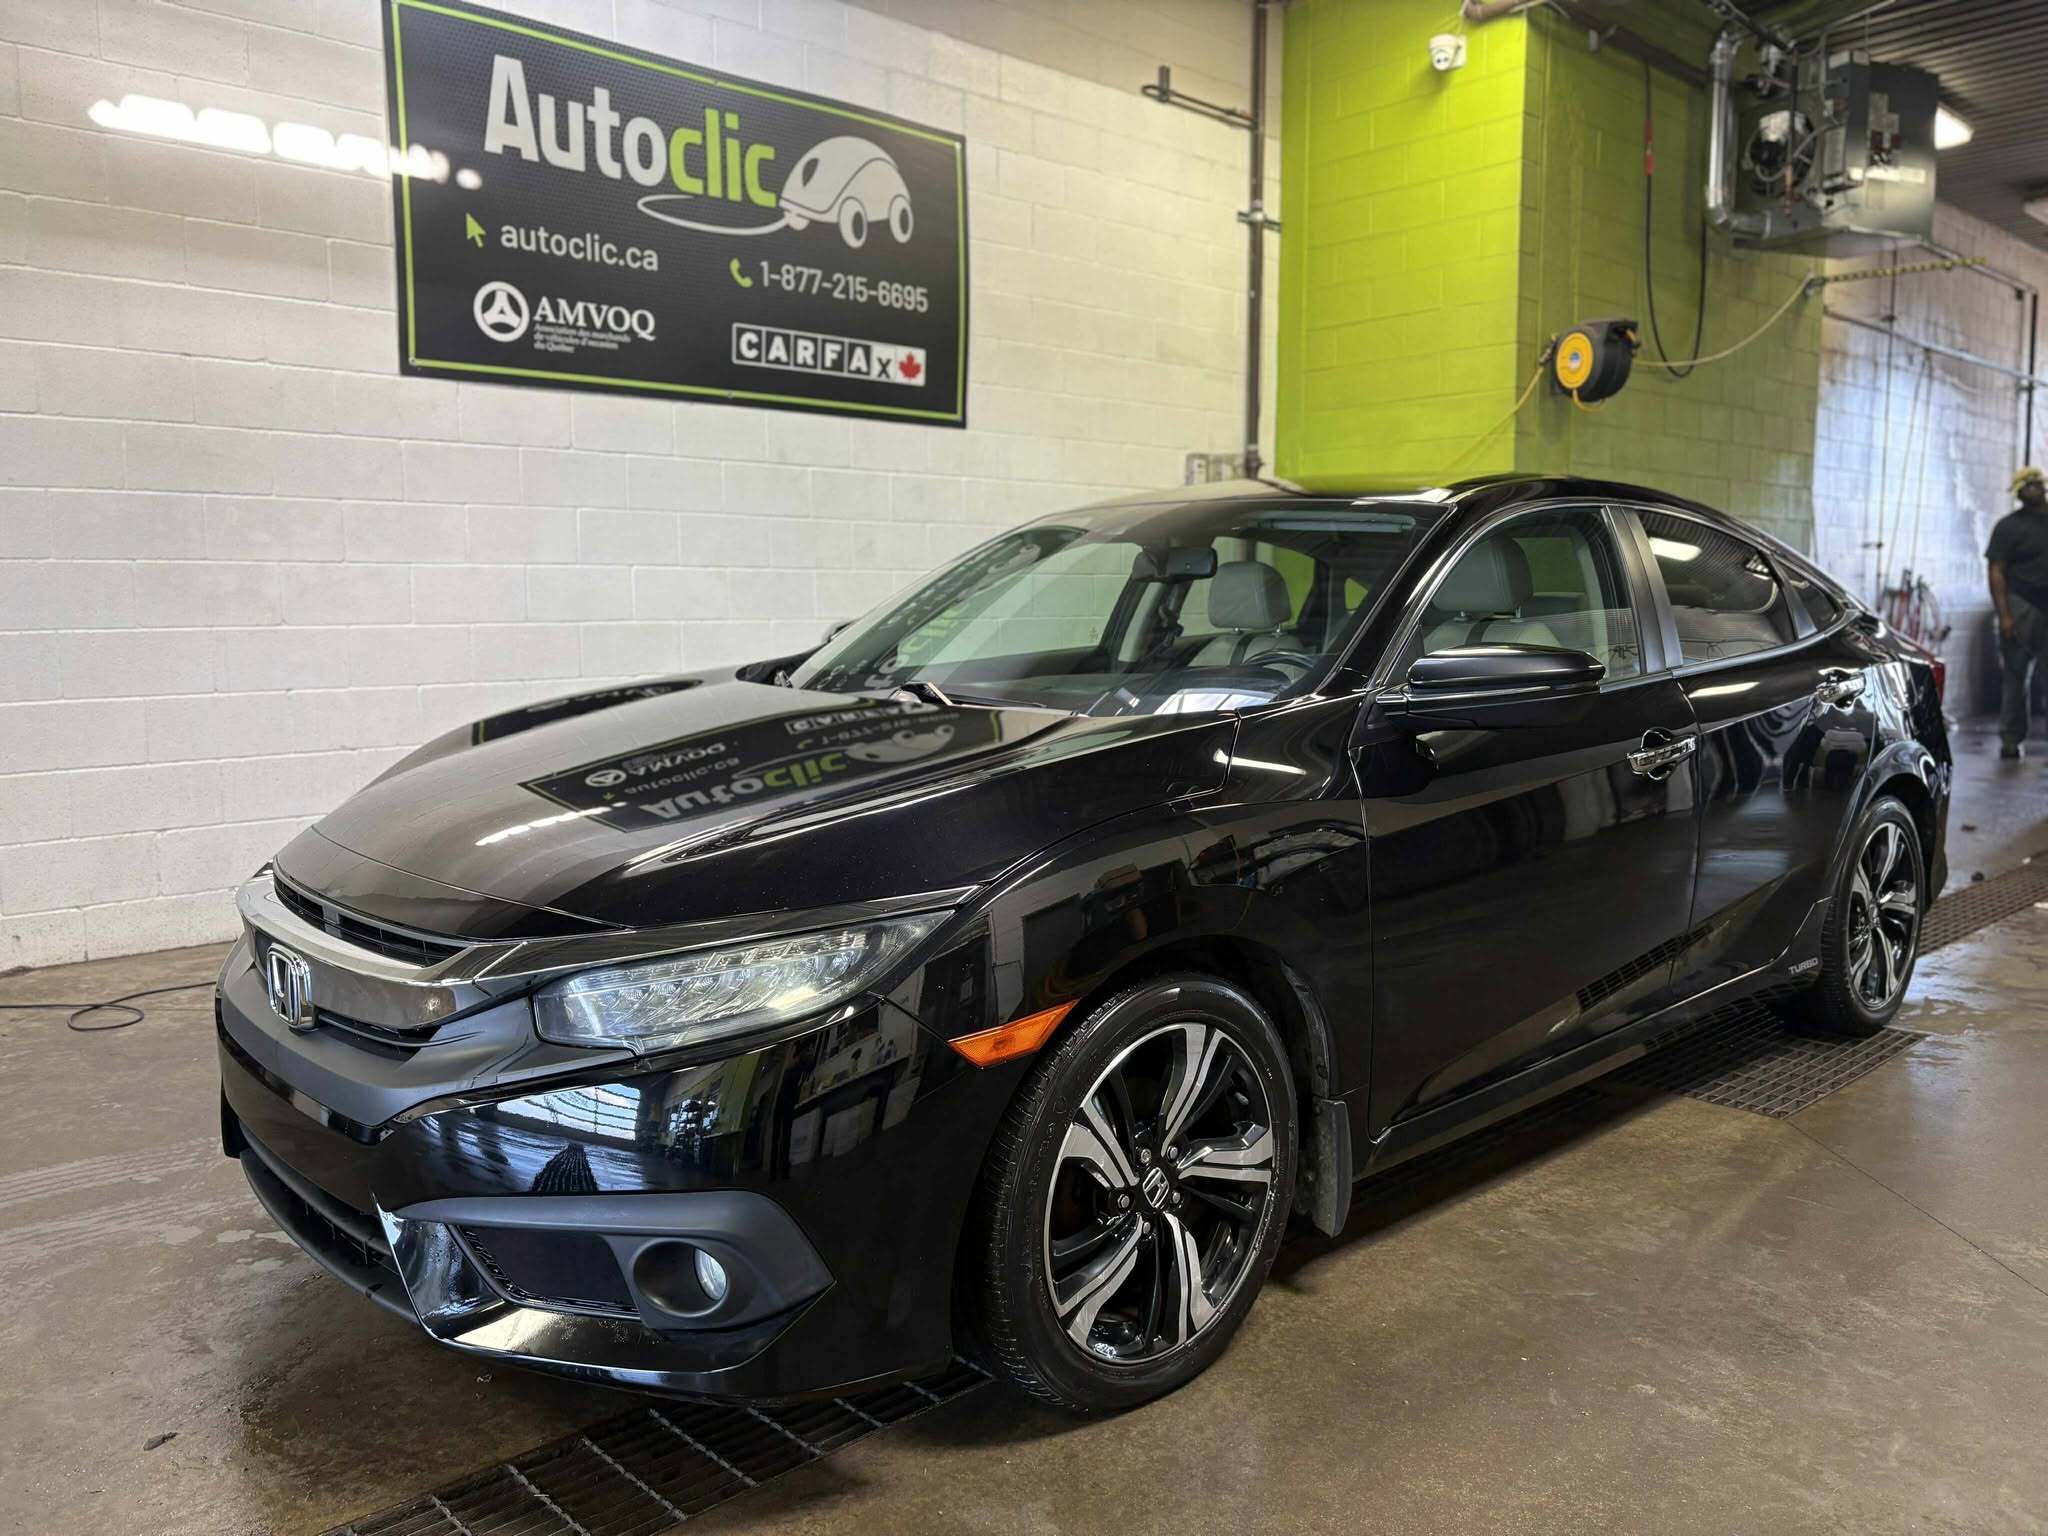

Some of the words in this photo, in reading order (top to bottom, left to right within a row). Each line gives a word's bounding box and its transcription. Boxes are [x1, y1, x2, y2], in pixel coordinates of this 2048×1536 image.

[484, 54, 777, 208] Autoclic
[501, 225, 659, 271] autoclic.ca
[760, 261, 928, 312] 1-877-215-6695
[533, 296, 656, 341] AMVOQ
[737, 330, 893, 381] CARFAX
[1788, 957, 1819, 975] TURBO
